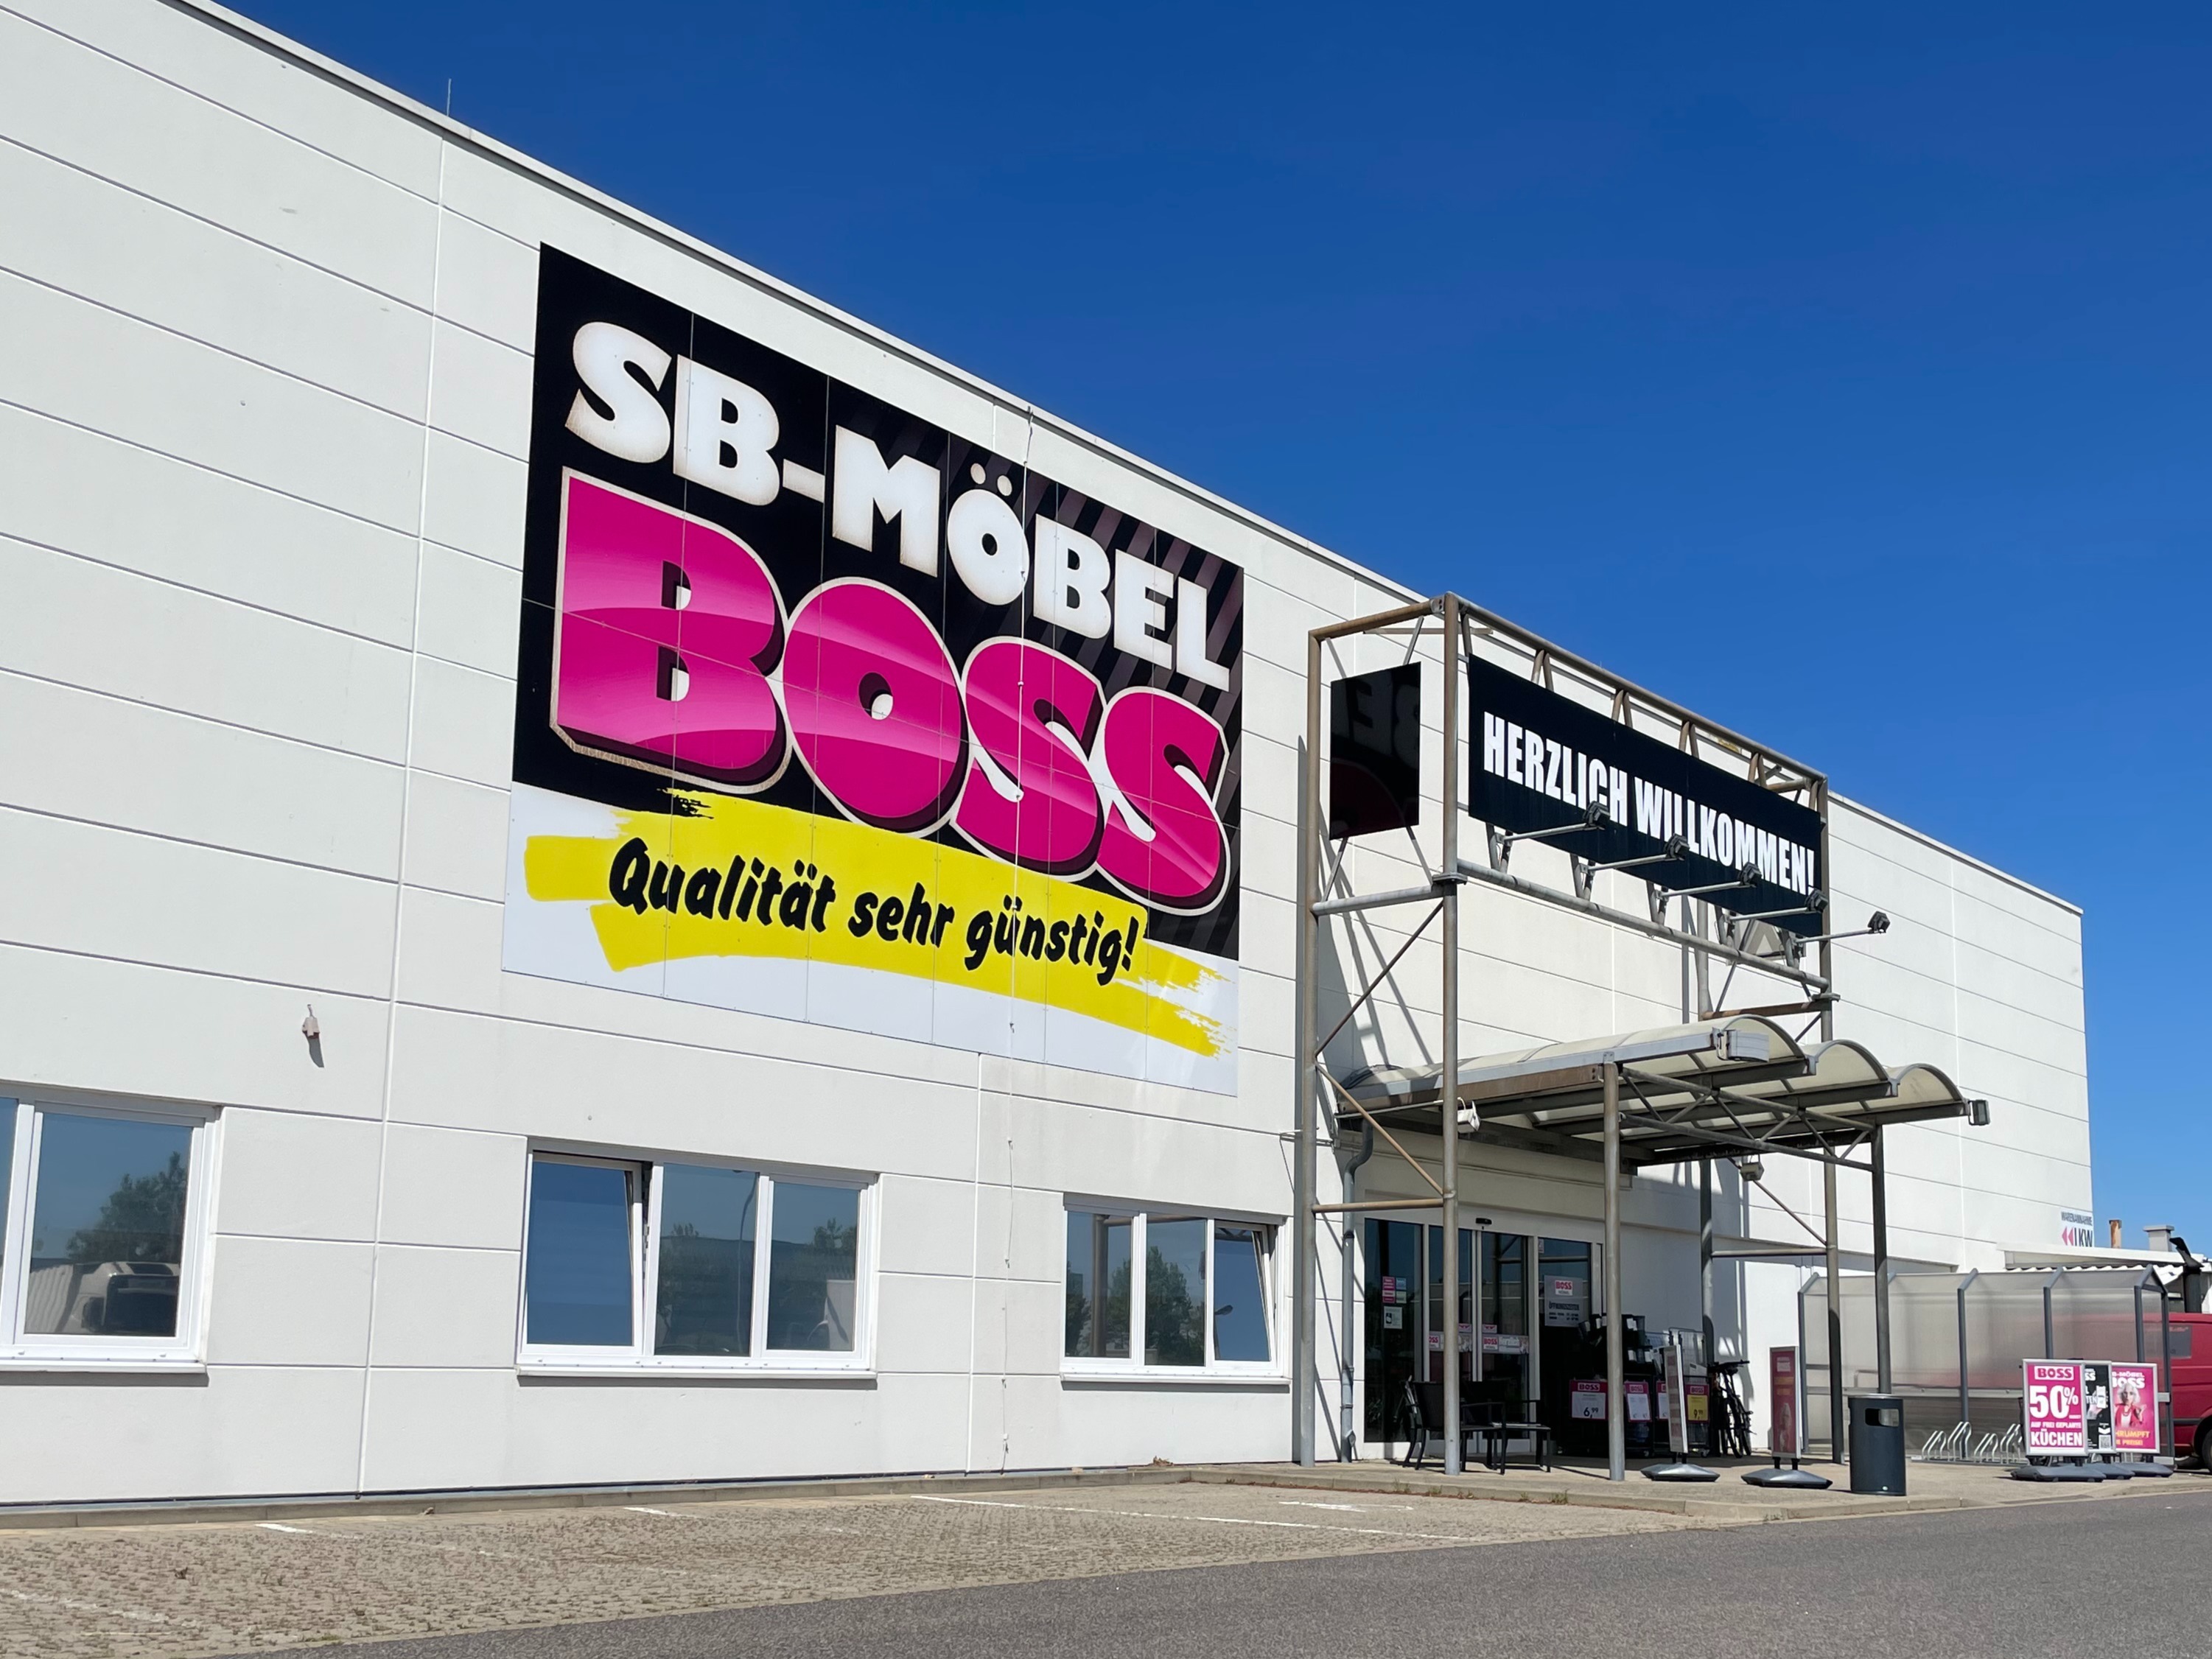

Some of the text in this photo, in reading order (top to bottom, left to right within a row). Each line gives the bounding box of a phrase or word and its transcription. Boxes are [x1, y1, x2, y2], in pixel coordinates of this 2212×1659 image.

[564, 321, 1231, 692] SB-MÖBEL
[550, 466, 1231, 916] BOSS
[1484, 711, 1628, 827] HERZLICH
[1634, 776, 1814, 896] WILLKOMMEN!
[608, 837, 1138, 986] Qualität sehr günstig!
[1555, 1281, 1572, 1290] BOSS
[2029, 1385, 2079, 1419] 50%
[2037, 1368, 2072, 1378] BOSS
[2031, 1428, 2082, 1446] KÜCHEN
